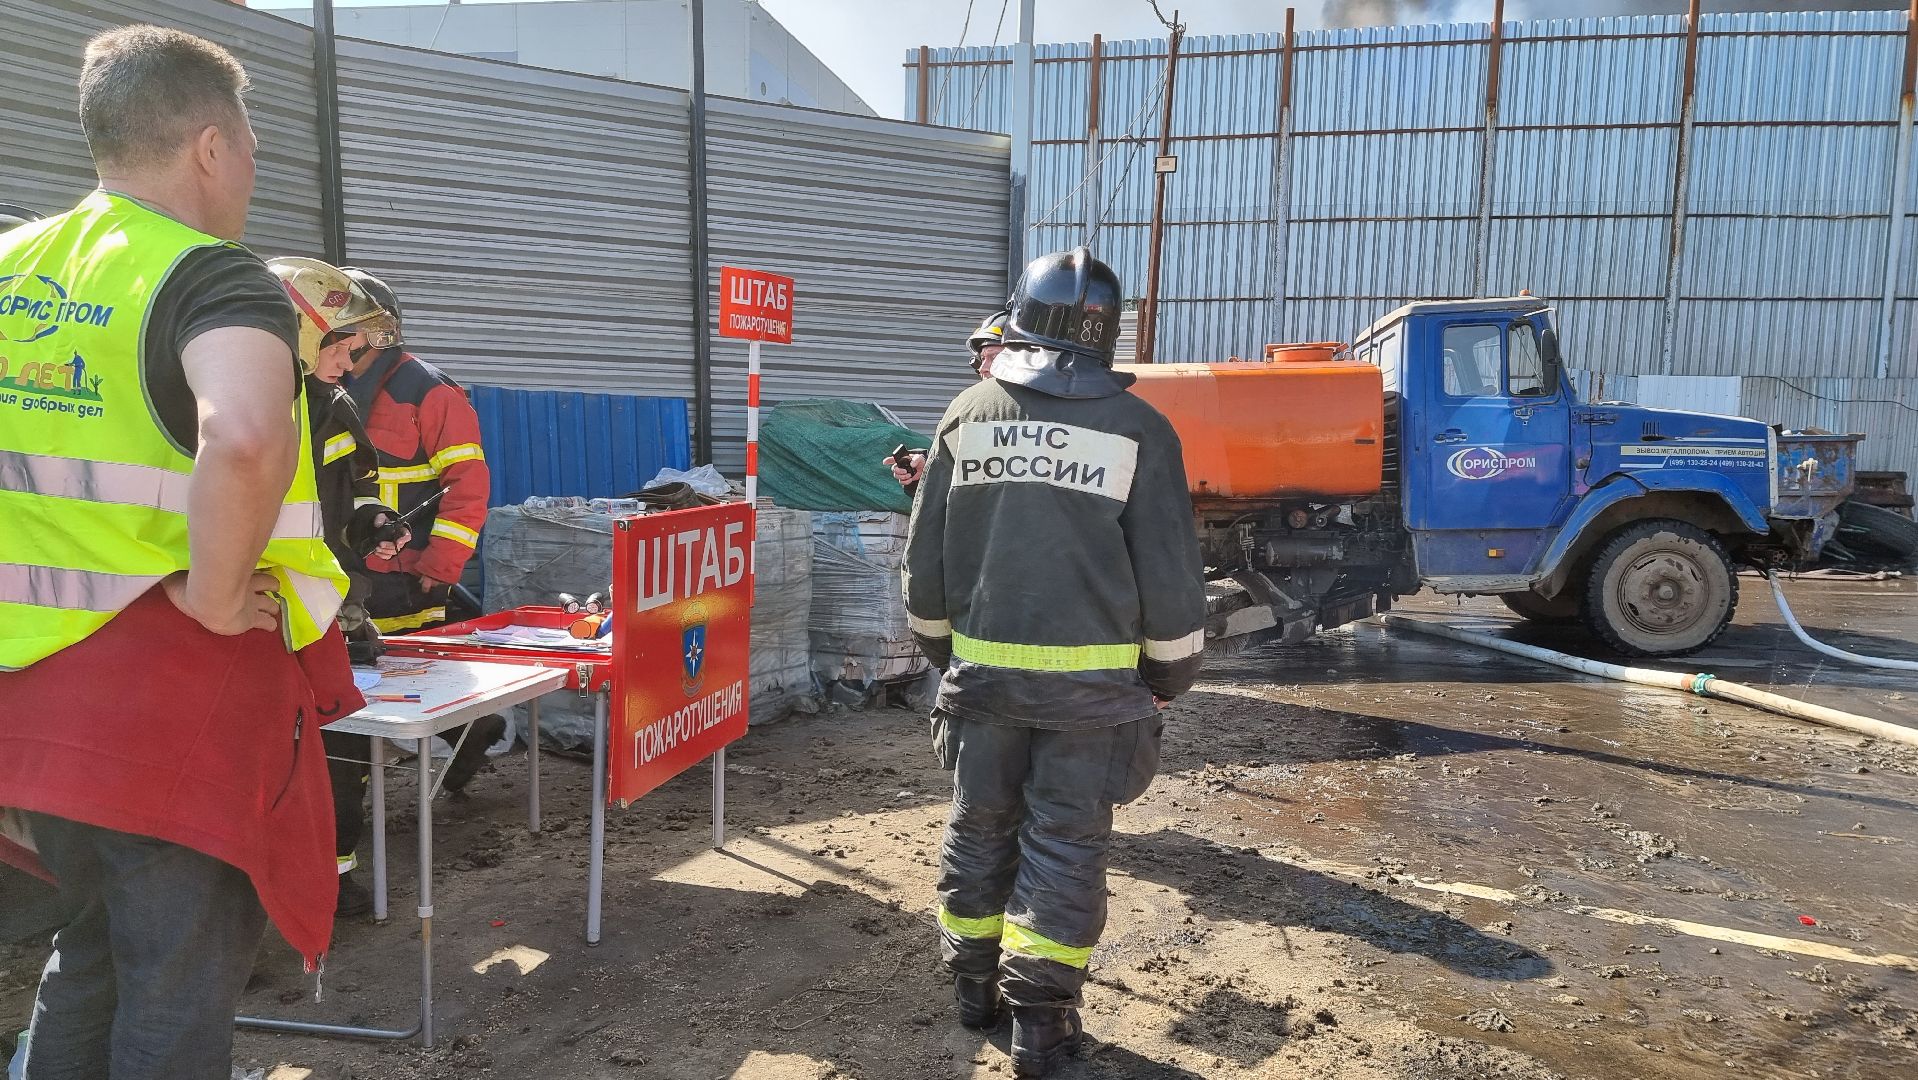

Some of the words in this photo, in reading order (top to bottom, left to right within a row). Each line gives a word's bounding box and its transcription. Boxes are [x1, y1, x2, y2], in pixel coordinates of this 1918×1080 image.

[730, 276, 787, 311] ШТАБ
[729, 313, 787, 337] ПОЖАРОТУШЕНИЯ
[1080, 319, 1104, 343] 89
[14, 361, 75, 392] ЛЕТ
[22, 396, 75, 414] добрых
[77, 404, 104, 419] дел
[993, 425, 1071, 450] МЧС
[960, 455, 1107, 489] РОССИИ
[1463, 457, 1536, 470] ОРИСПРОМ
[636, 521, 746, 613] ШТАБ
[633, 679, 743, 770] ПОЖАРОТУШЕНИЯ
